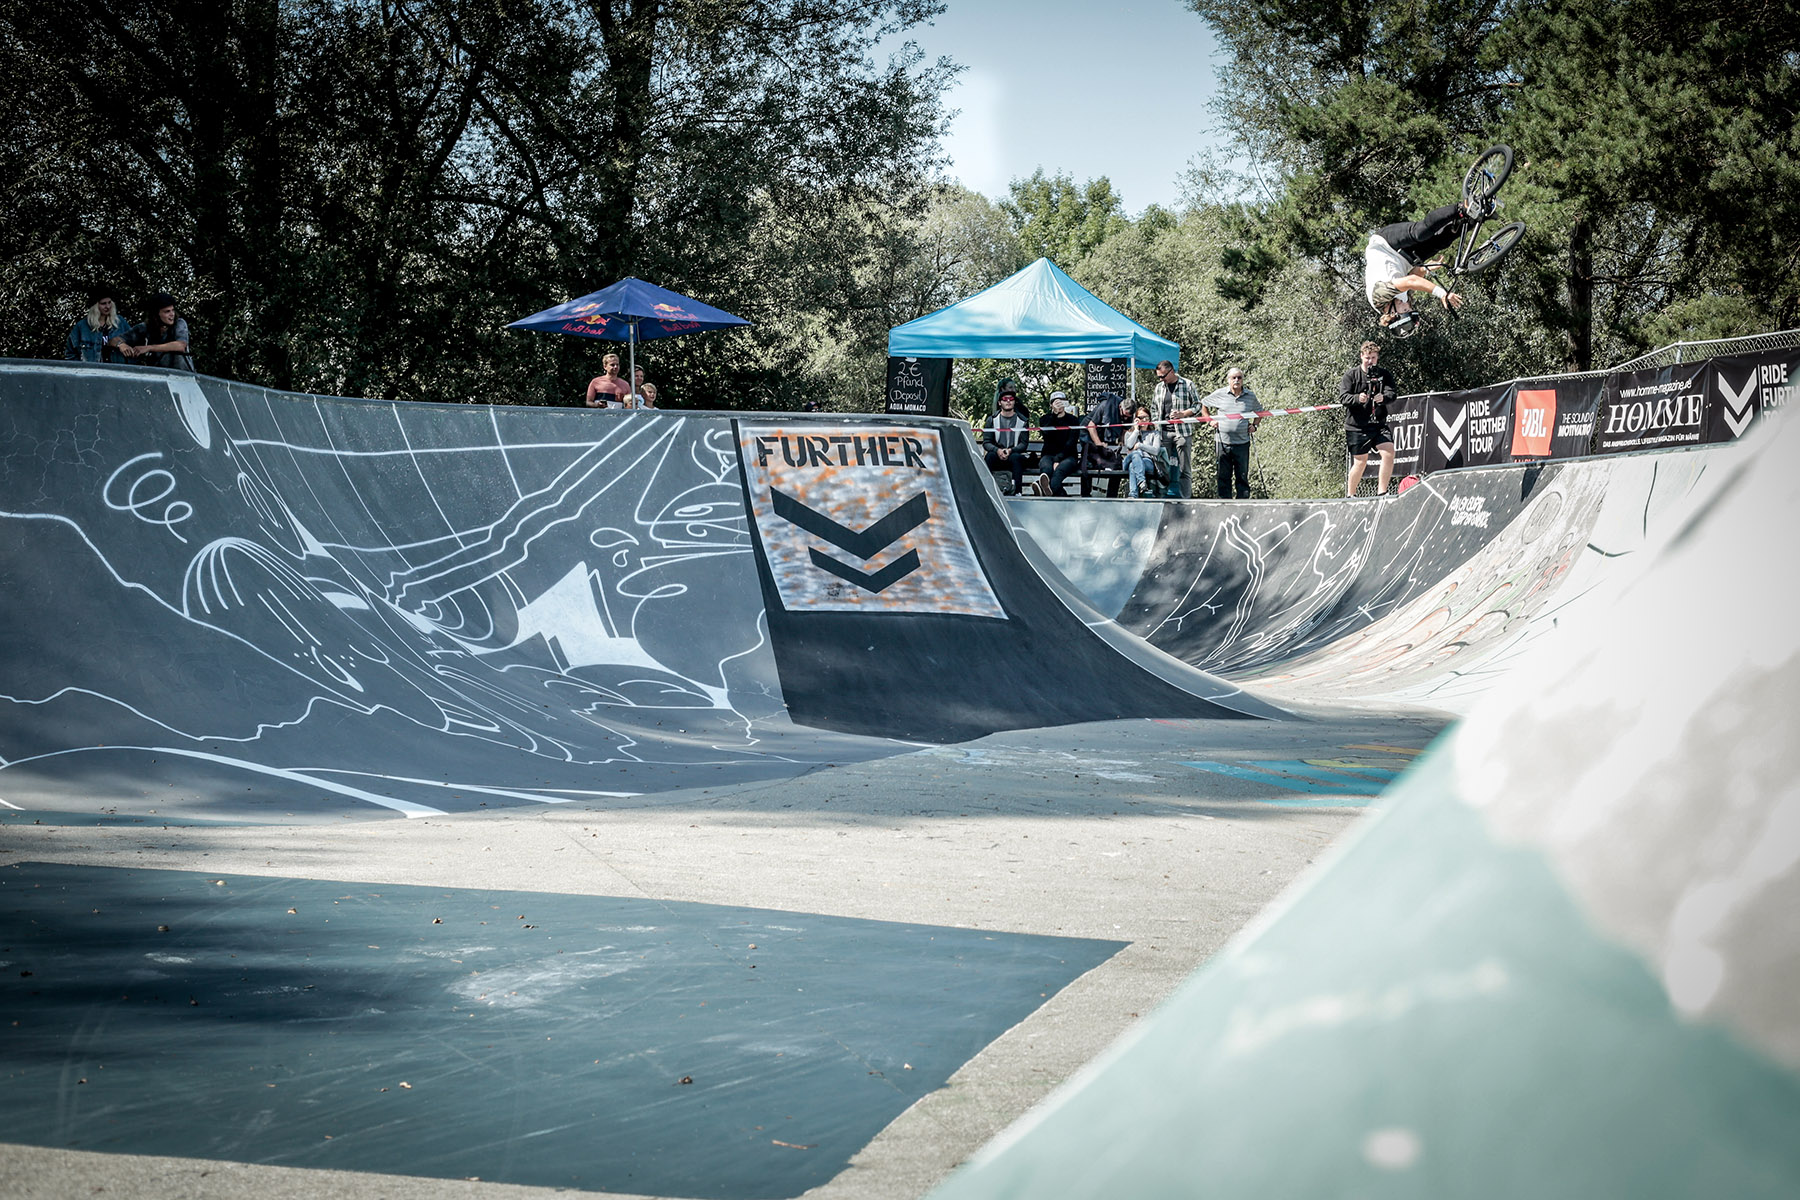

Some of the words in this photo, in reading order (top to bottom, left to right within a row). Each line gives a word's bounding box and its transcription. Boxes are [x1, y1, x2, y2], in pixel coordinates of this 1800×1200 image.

[1088, 363, 1105, 373] Bier
[1761, 363, 1788, 385] RIDE
[894, 375, 924, 389] Pfand
[1087, 373, 1109, 382] Radler
[1762, 385, 1800, 407] FURT
[889, 403, 904, 411] AQUA
[904, 404, 927, 412] MONACO
[1469, 400, 1491, 418] RIDE
[1604, 394, 1704, 433] HOMME
[1470, 415, 1507, 436] FURTHER
[1521, 408, 1547, 438] JBL
[1470, 436, 1494, 454] TOUR
[1675, 433, 1685, 441] FÜR
[756, 436, 927, 469] FURTHER
